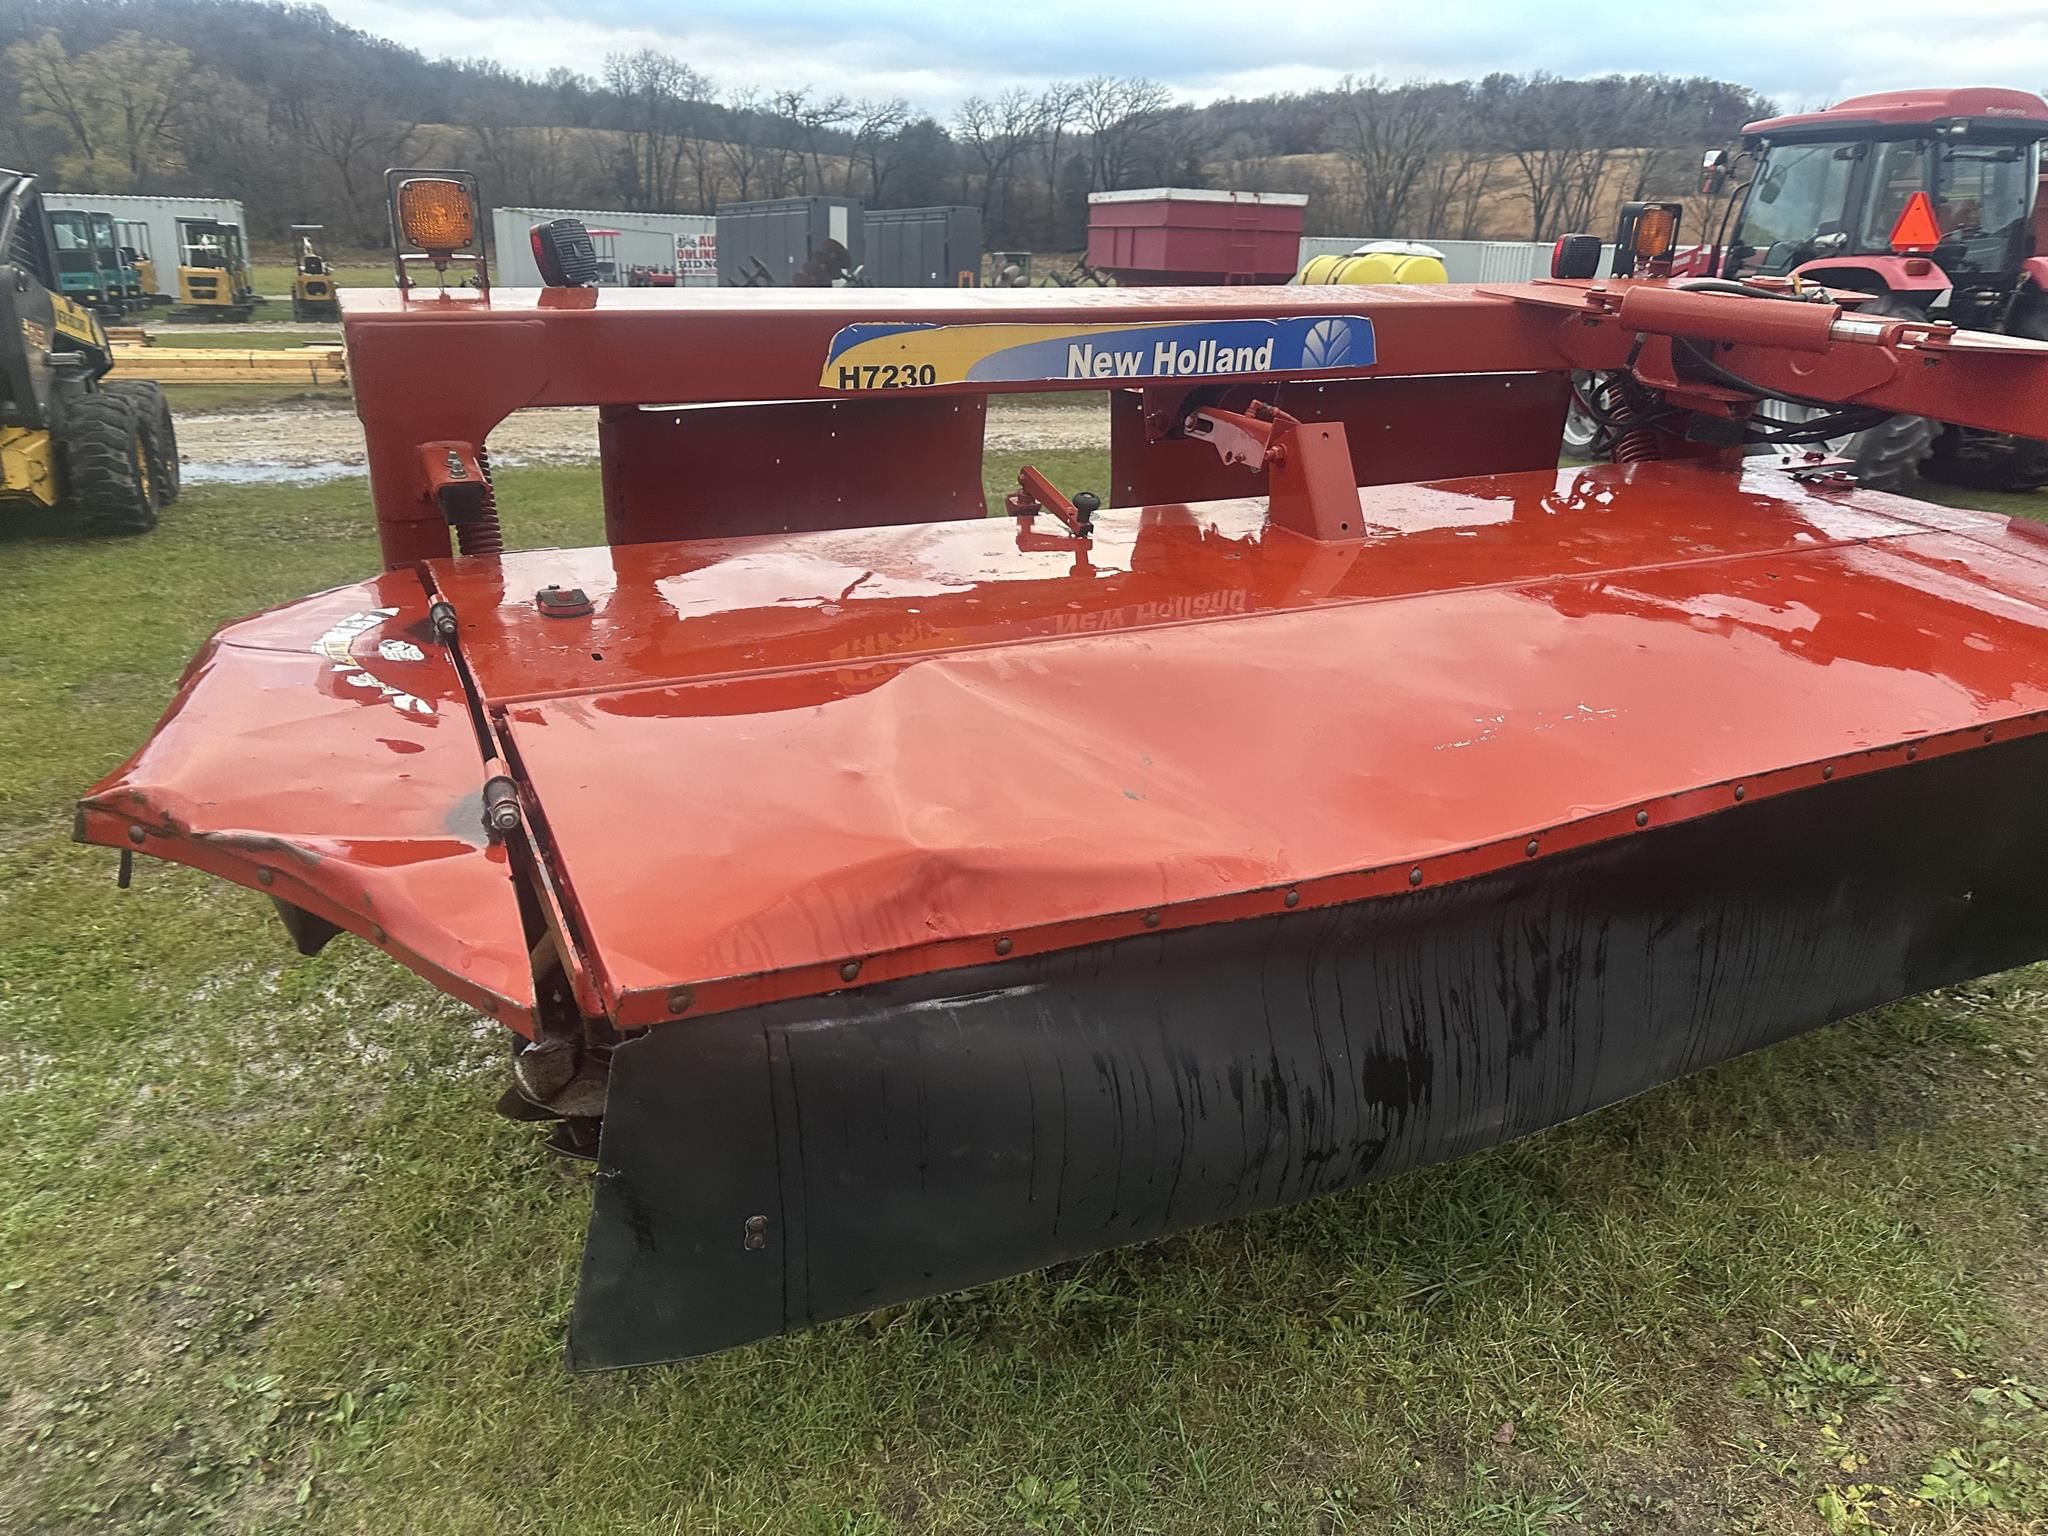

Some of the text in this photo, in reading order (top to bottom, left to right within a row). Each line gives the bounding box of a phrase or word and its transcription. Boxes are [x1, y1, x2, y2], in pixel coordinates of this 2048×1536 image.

[1067, 337, 1275, 377] New Holland
[839, 364, 936, 389] H7230
